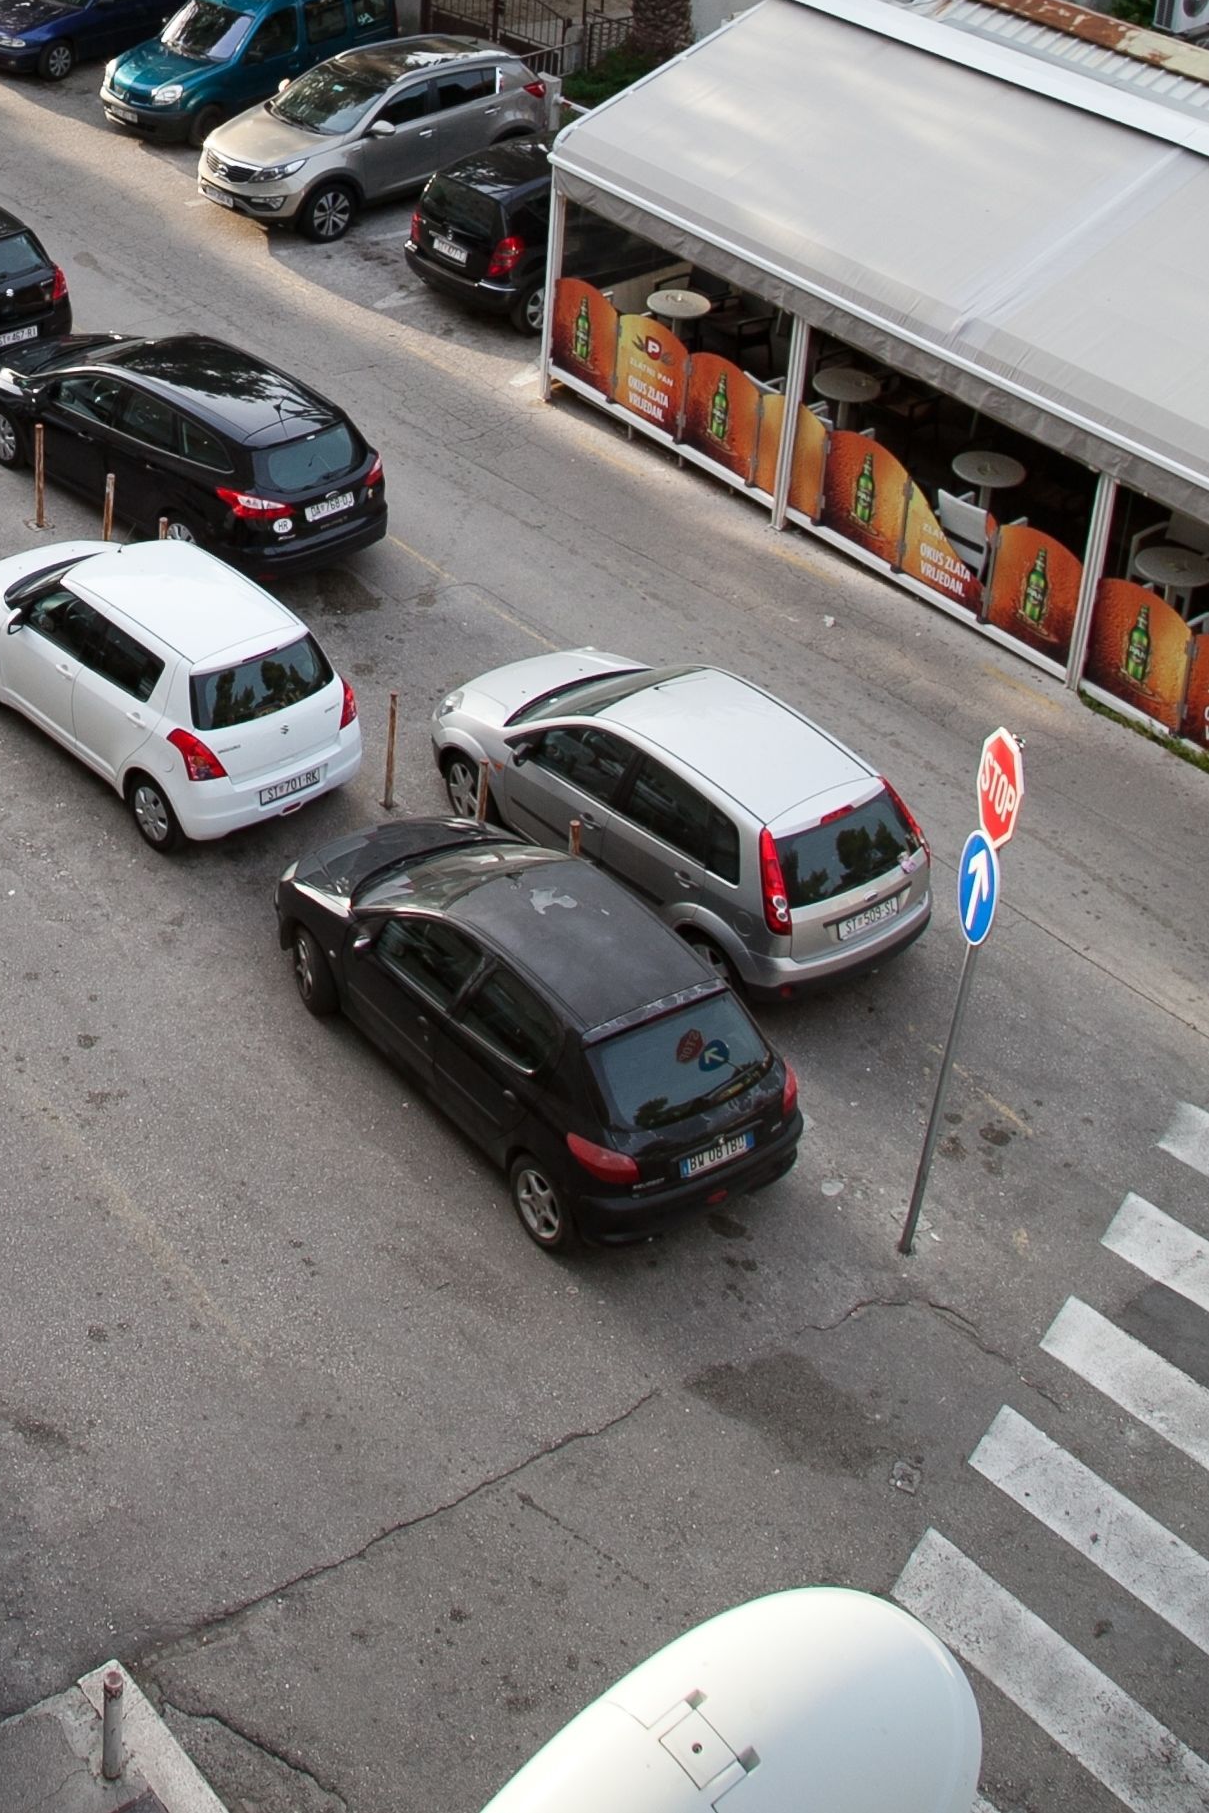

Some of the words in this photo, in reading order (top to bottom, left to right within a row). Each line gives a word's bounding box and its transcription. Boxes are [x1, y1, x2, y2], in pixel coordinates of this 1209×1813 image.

[627, 375, 647, 395] OKUS
[647, 385, 669, 408] ZLATA
[657, 373, 674, 388] PAN
[278, 520, 289, 531] HR
[920, 542, 945, 566] OKUS
[945, 555, 971, 583] ZLATA
[981, 751, 1016, 823] STOP
